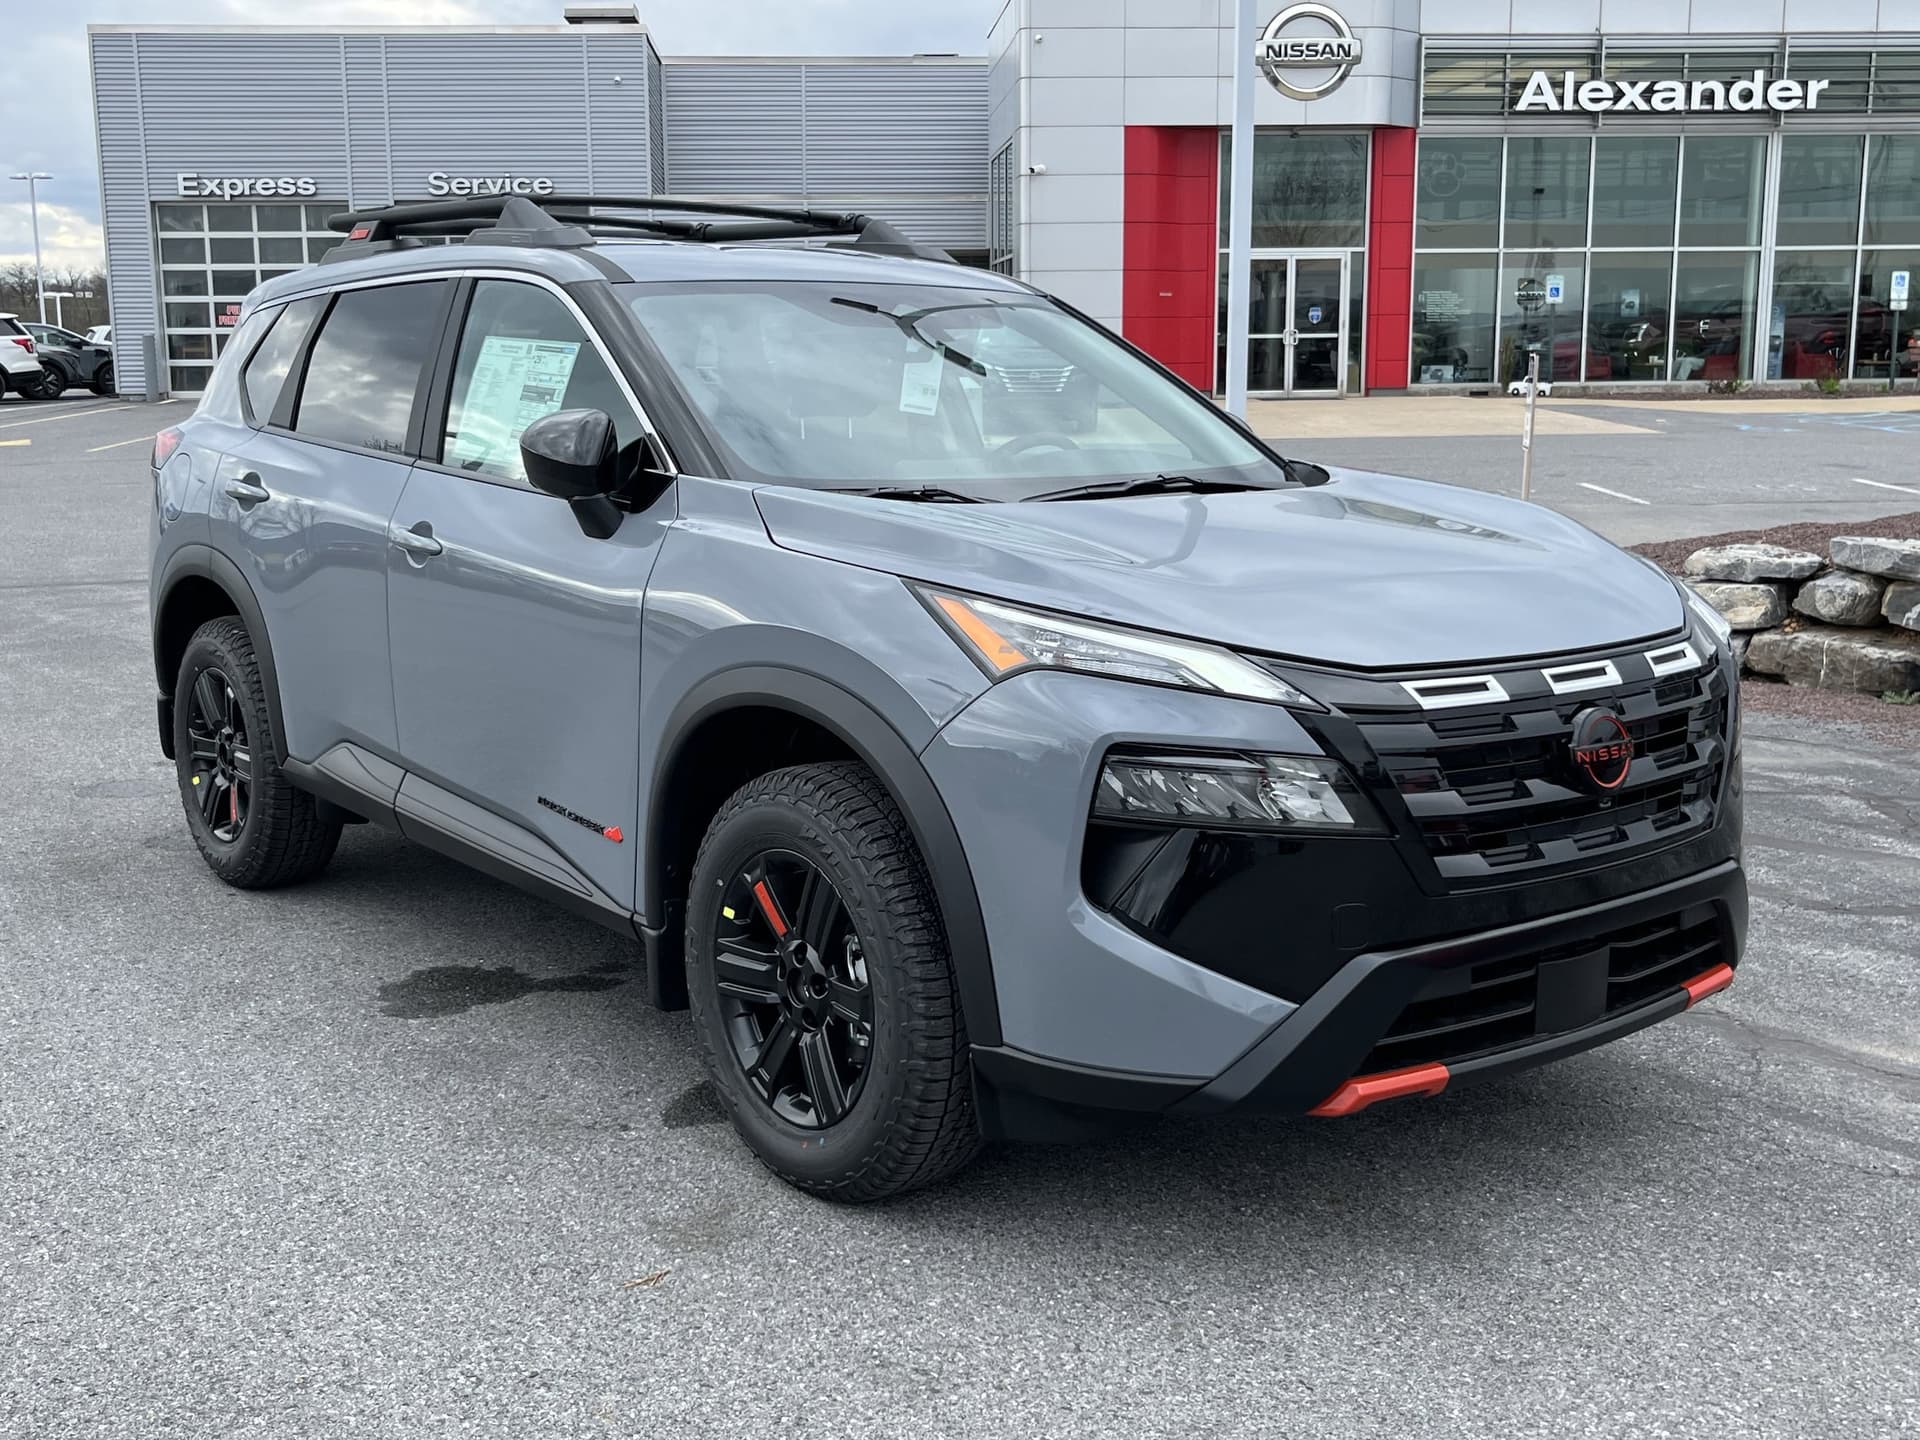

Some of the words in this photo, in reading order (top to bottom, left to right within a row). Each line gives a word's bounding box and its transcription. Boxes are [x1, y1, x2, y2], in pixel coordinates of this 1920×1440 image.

[1266, 43, 1352, 59] NISSAN
[1515, 70, 1829, 111] Alexander
[177, 173, 316, 200] Express
[428, 172, 553, 195] Service
[1576, 742, 1633, 764] NISSAN
